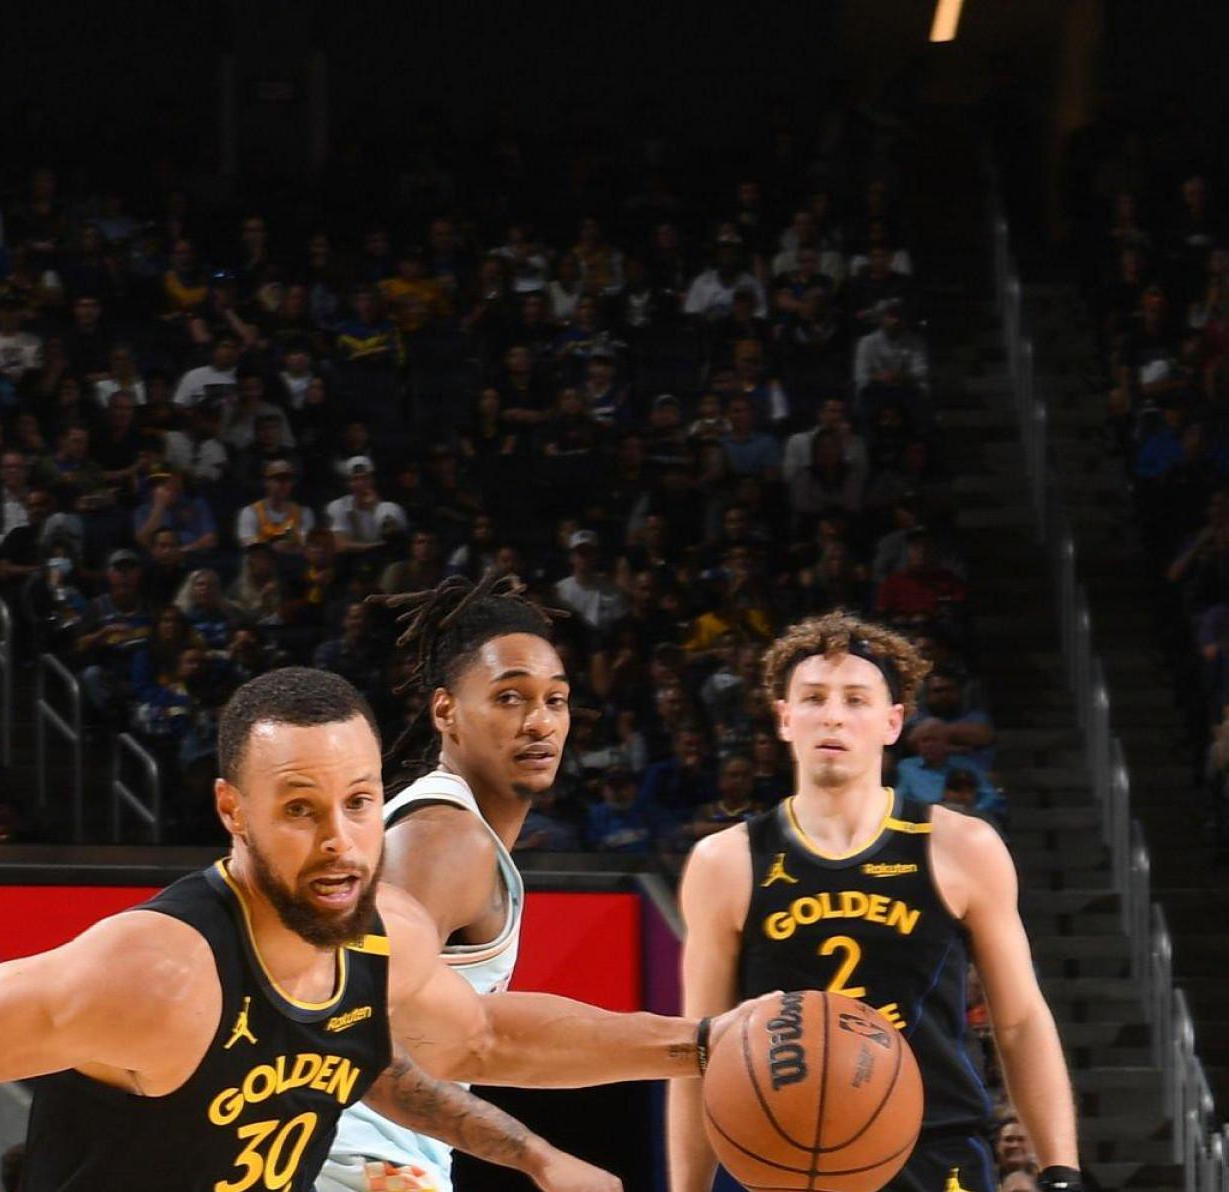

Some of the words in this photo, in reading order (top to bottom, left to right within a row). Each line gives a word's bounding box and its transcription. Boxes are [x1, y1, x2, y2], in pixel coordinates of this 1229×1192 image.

[861, 863, 918, 878] Rakuten
[765, 891, 921, 940] GOLDEN
[820, 935, 866, 998] 2
[326, 1006, 372, 1032] Rakuten
[208, 1053, 360, 1126] GOLDEN
